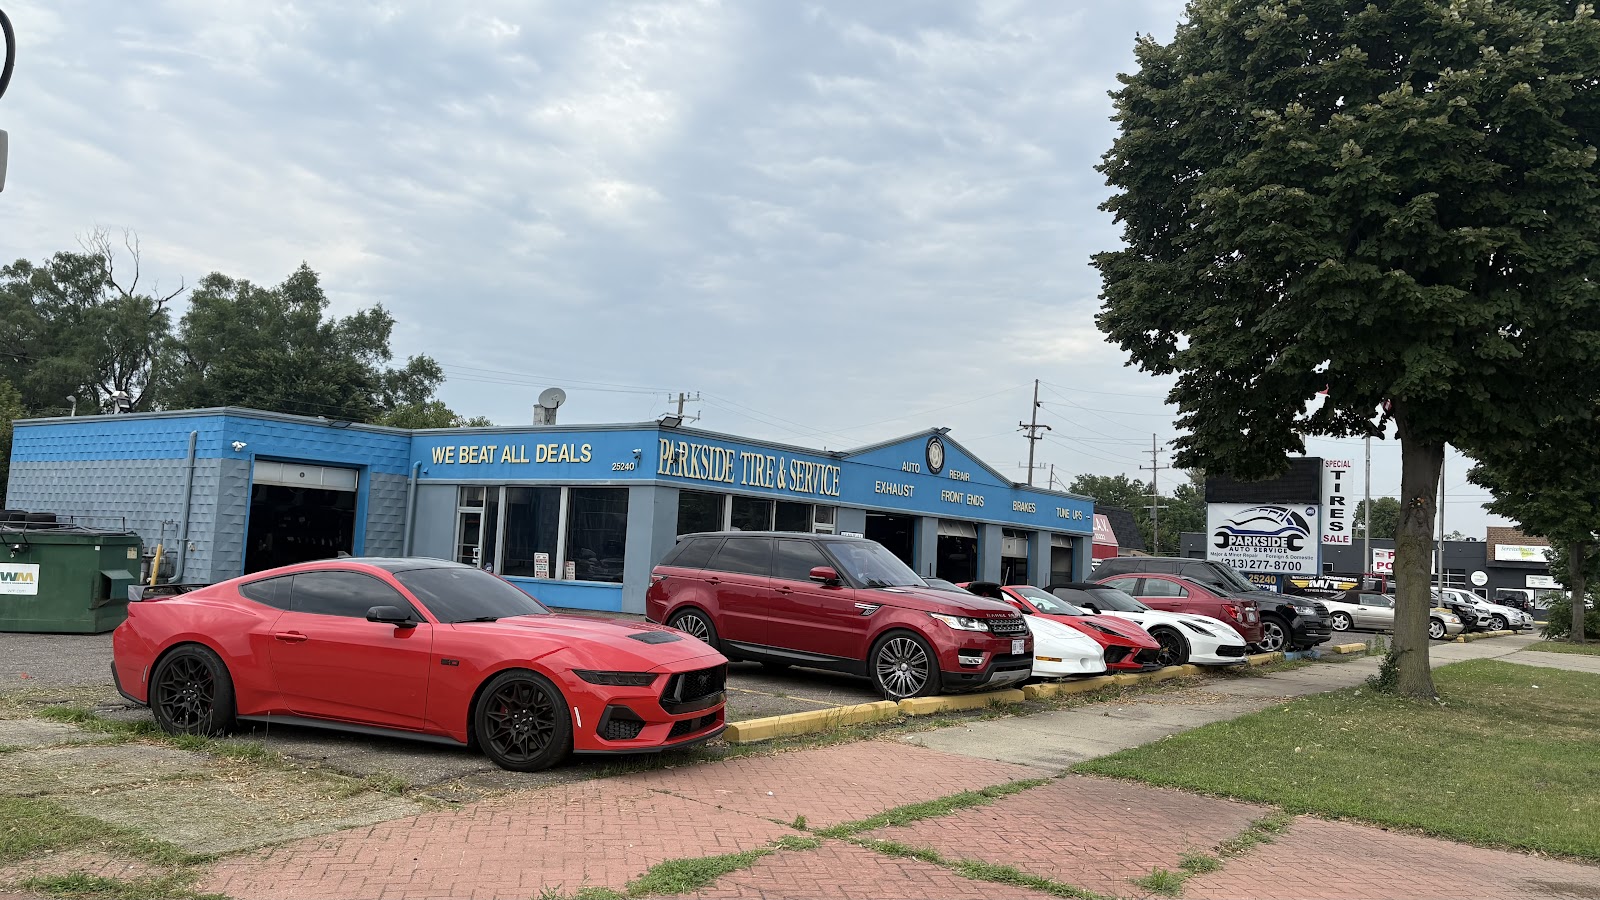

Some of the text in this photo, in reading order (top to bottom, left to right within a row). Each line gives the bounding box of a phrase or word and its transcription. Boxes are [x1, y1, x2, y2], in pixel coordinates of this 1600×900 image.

[432, 443, 592, 464] WE BEAT ALL DEALS
[612, 462, 635, 471] 25240
[657, 438, 840, 496] PARKSIDE TIRE & SERVICE
[1325, 460, 1351, 468] SPECIAL
[901, 461, 970, 481] AUTO REPAIR
[875, 480, 914, 497] EXHAUST
[941, 490, 984, 507] FRONT ENDS
[1329, 470, 1346, 532] TIRES
[1012, 500, 1036, 513] BRAKES
[1056, 507, 1083, 520] TUNE UPS
[1229, 536, 1288, 547] PARKSIDE
[1323, 534, 1349, 543] SALE
[0, 571, 34, 581] WM
[1248, 574, 1276, 584] 25240
